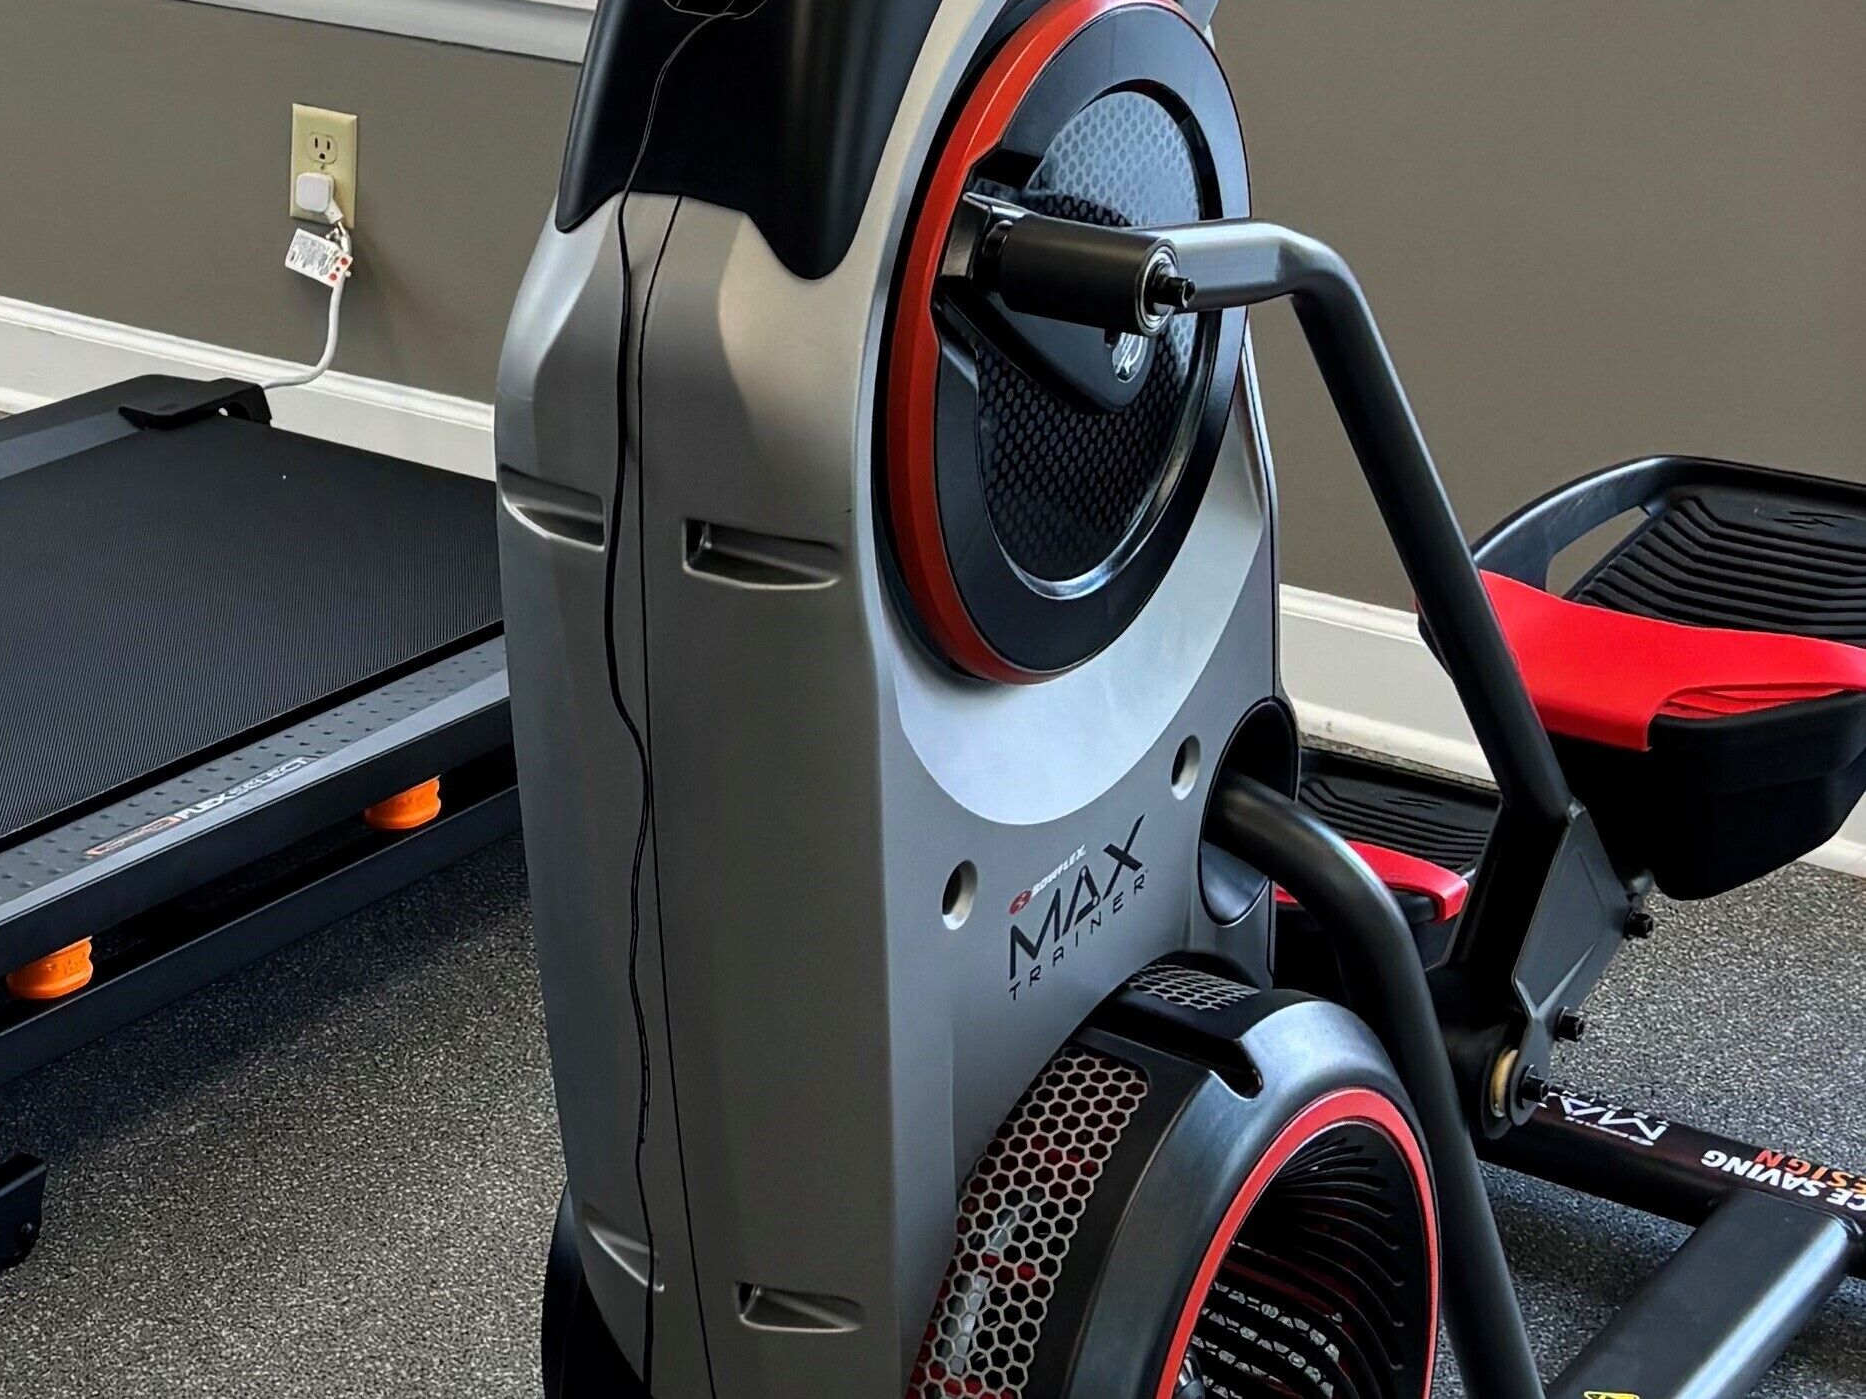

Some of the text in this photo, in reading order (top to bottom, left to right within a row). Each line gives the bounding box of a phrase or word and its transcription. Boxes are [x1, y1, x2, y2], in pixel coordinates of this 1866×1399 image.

[1008, 813, 1146, 982] MAX
[1008, 874, 1145, 1001] TRAINER
[1538, 1090, 1669, 1141] MA
[1700, 1149, 1827, 1197] SAVING
